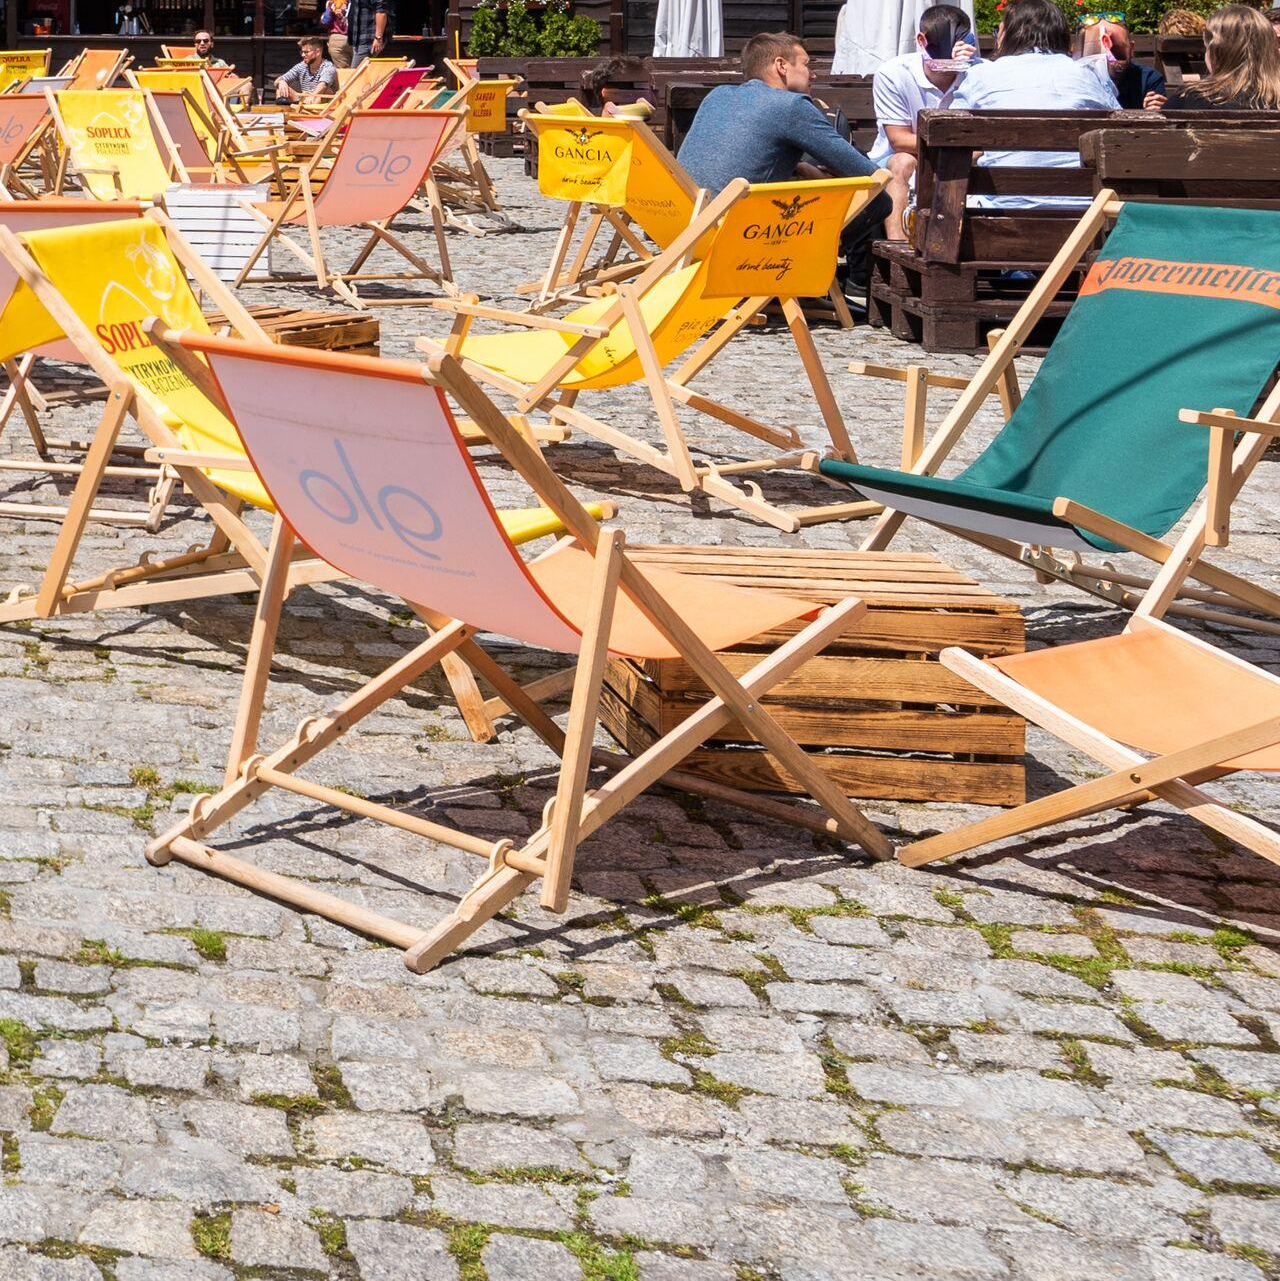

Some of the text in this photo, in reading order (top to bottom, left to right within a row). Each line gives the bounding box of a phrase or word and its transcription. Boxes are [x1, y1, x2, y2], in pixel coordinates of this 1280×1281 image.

[86, 126, 132, 139] SOPLICA
[554, 145, 613, 163] GANCIA
[743, 220, 815, 240] GANCIA
